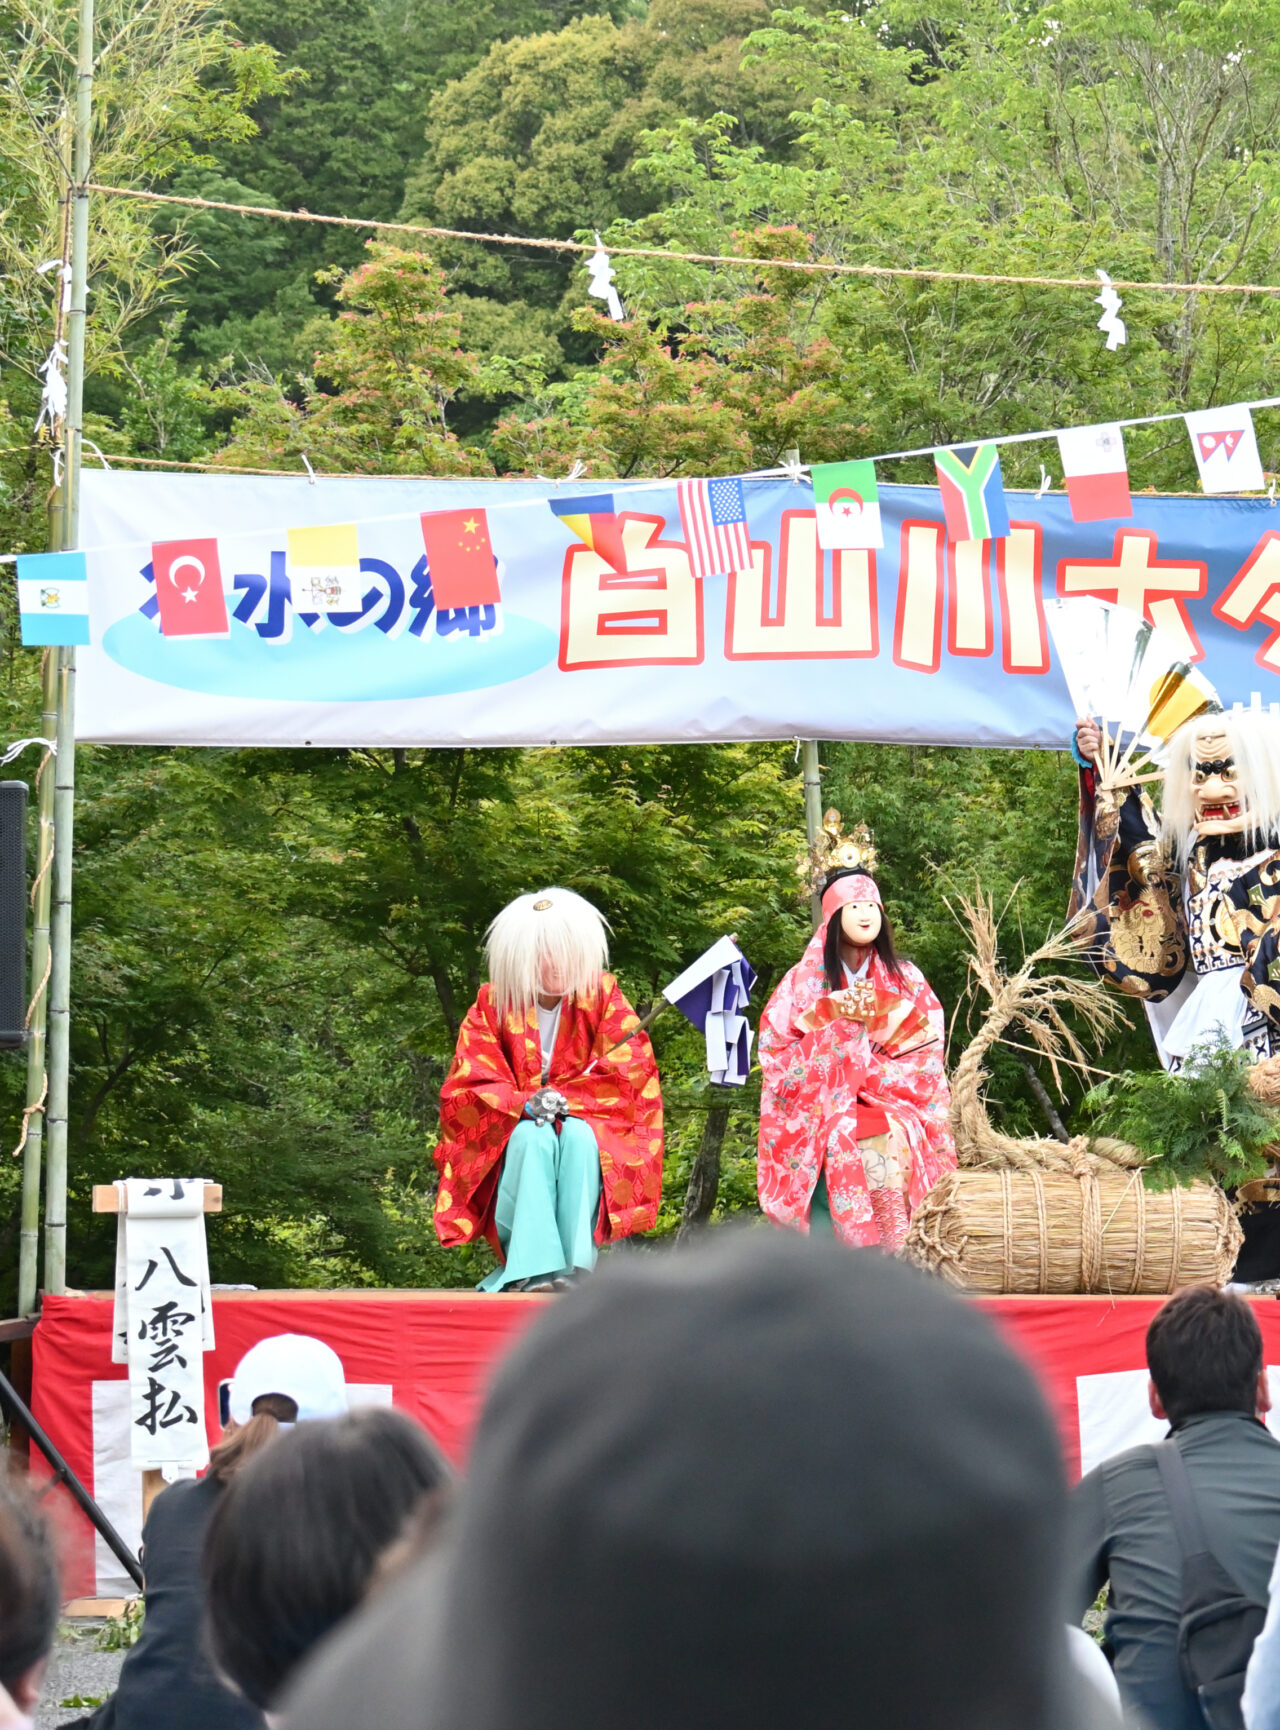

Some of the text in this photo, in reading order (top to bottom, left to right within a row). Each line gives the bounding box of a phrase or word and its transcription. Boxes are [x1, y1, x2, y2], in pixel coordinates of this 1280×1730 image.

[138, 550, 500, 638] 水の
[134, 1246, 199, 1436] 八雲払
